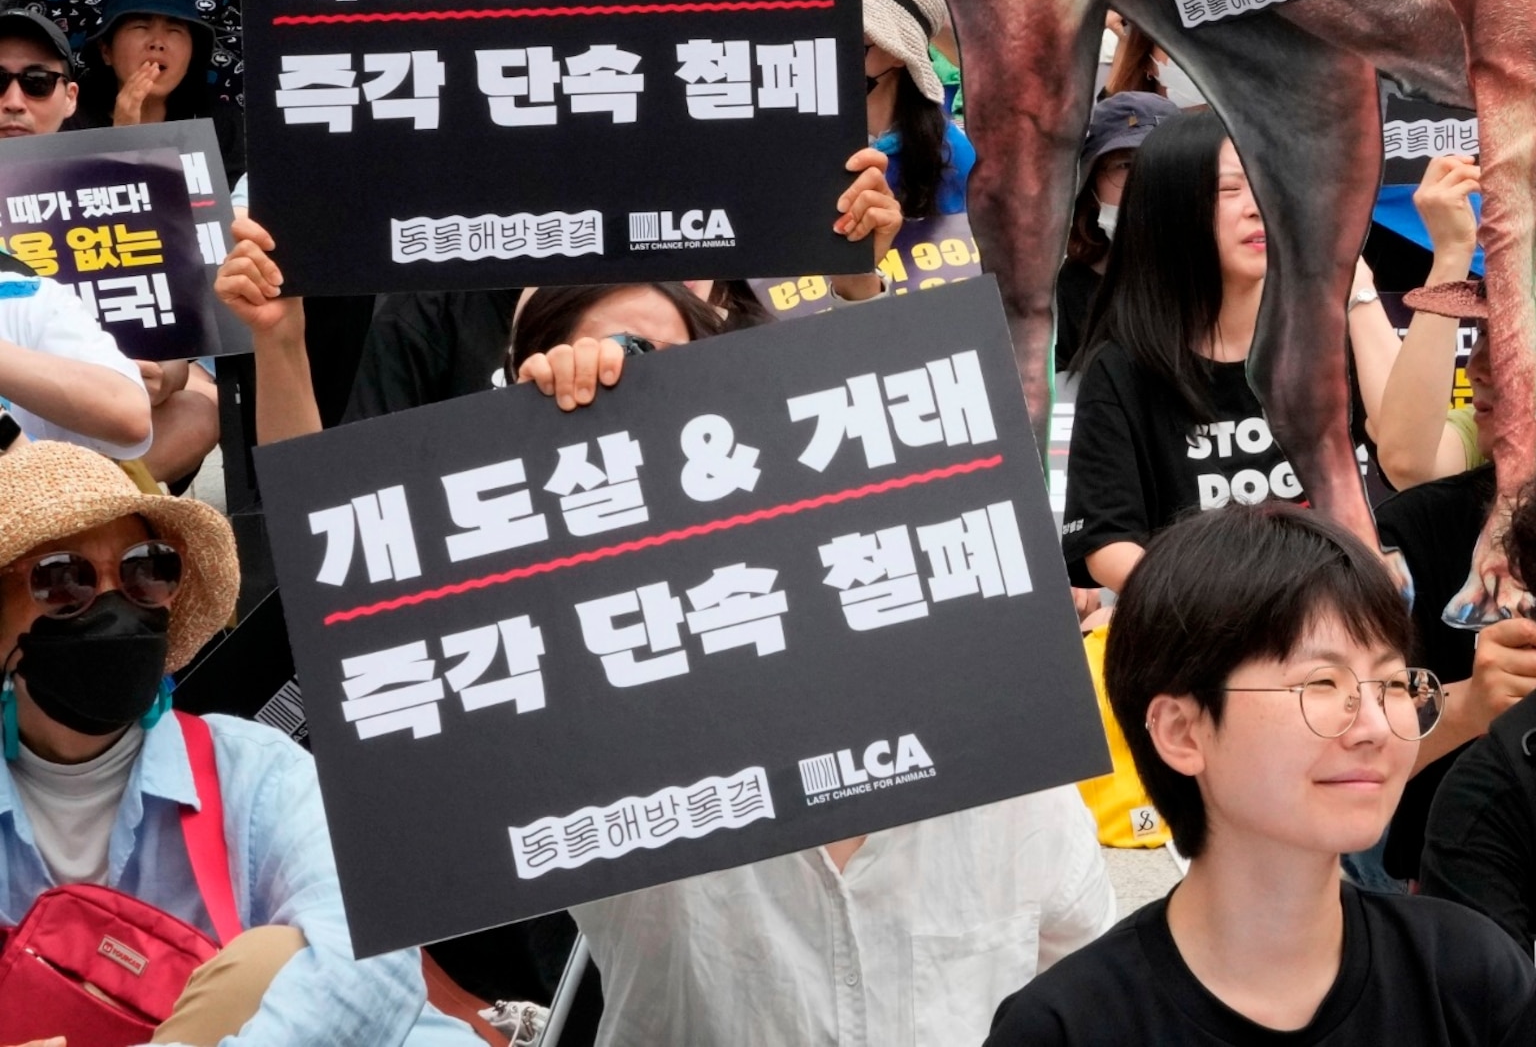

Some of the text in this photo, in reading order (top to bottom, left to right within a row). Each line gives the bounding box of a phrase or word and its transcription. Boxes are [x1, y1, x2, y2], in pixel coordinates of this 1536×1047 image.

[275, 37, 839, 133] 즉각 단속 철폐
[7, 182, 152, 224] 때가 됐다!
[660, 209, 736, 240] LCA
[66, 223, 163, 272] 없는
[399, 216, 597, 256] 동물해방물결
[630, 239, 736, 251] LAST CHANCE FOR ANIMALS
[1186, 417, 1278, 460] STO
[309, 485, 422, 587] 개
[442, 432, 649, 563] 도살
[680, 413, 762, 502] &
[787, 350, 998, 474] 거래
[1198, 469, 1304, 511] DOG
[341, 499, 1033, 740] 즉각 단속 철폐
[838, 733, 934, 785] LCA
[806, 767, 937, 806] LAST CHANCE FOR ANIMALS
[522, 774, 766, 868] 동물해방물결
